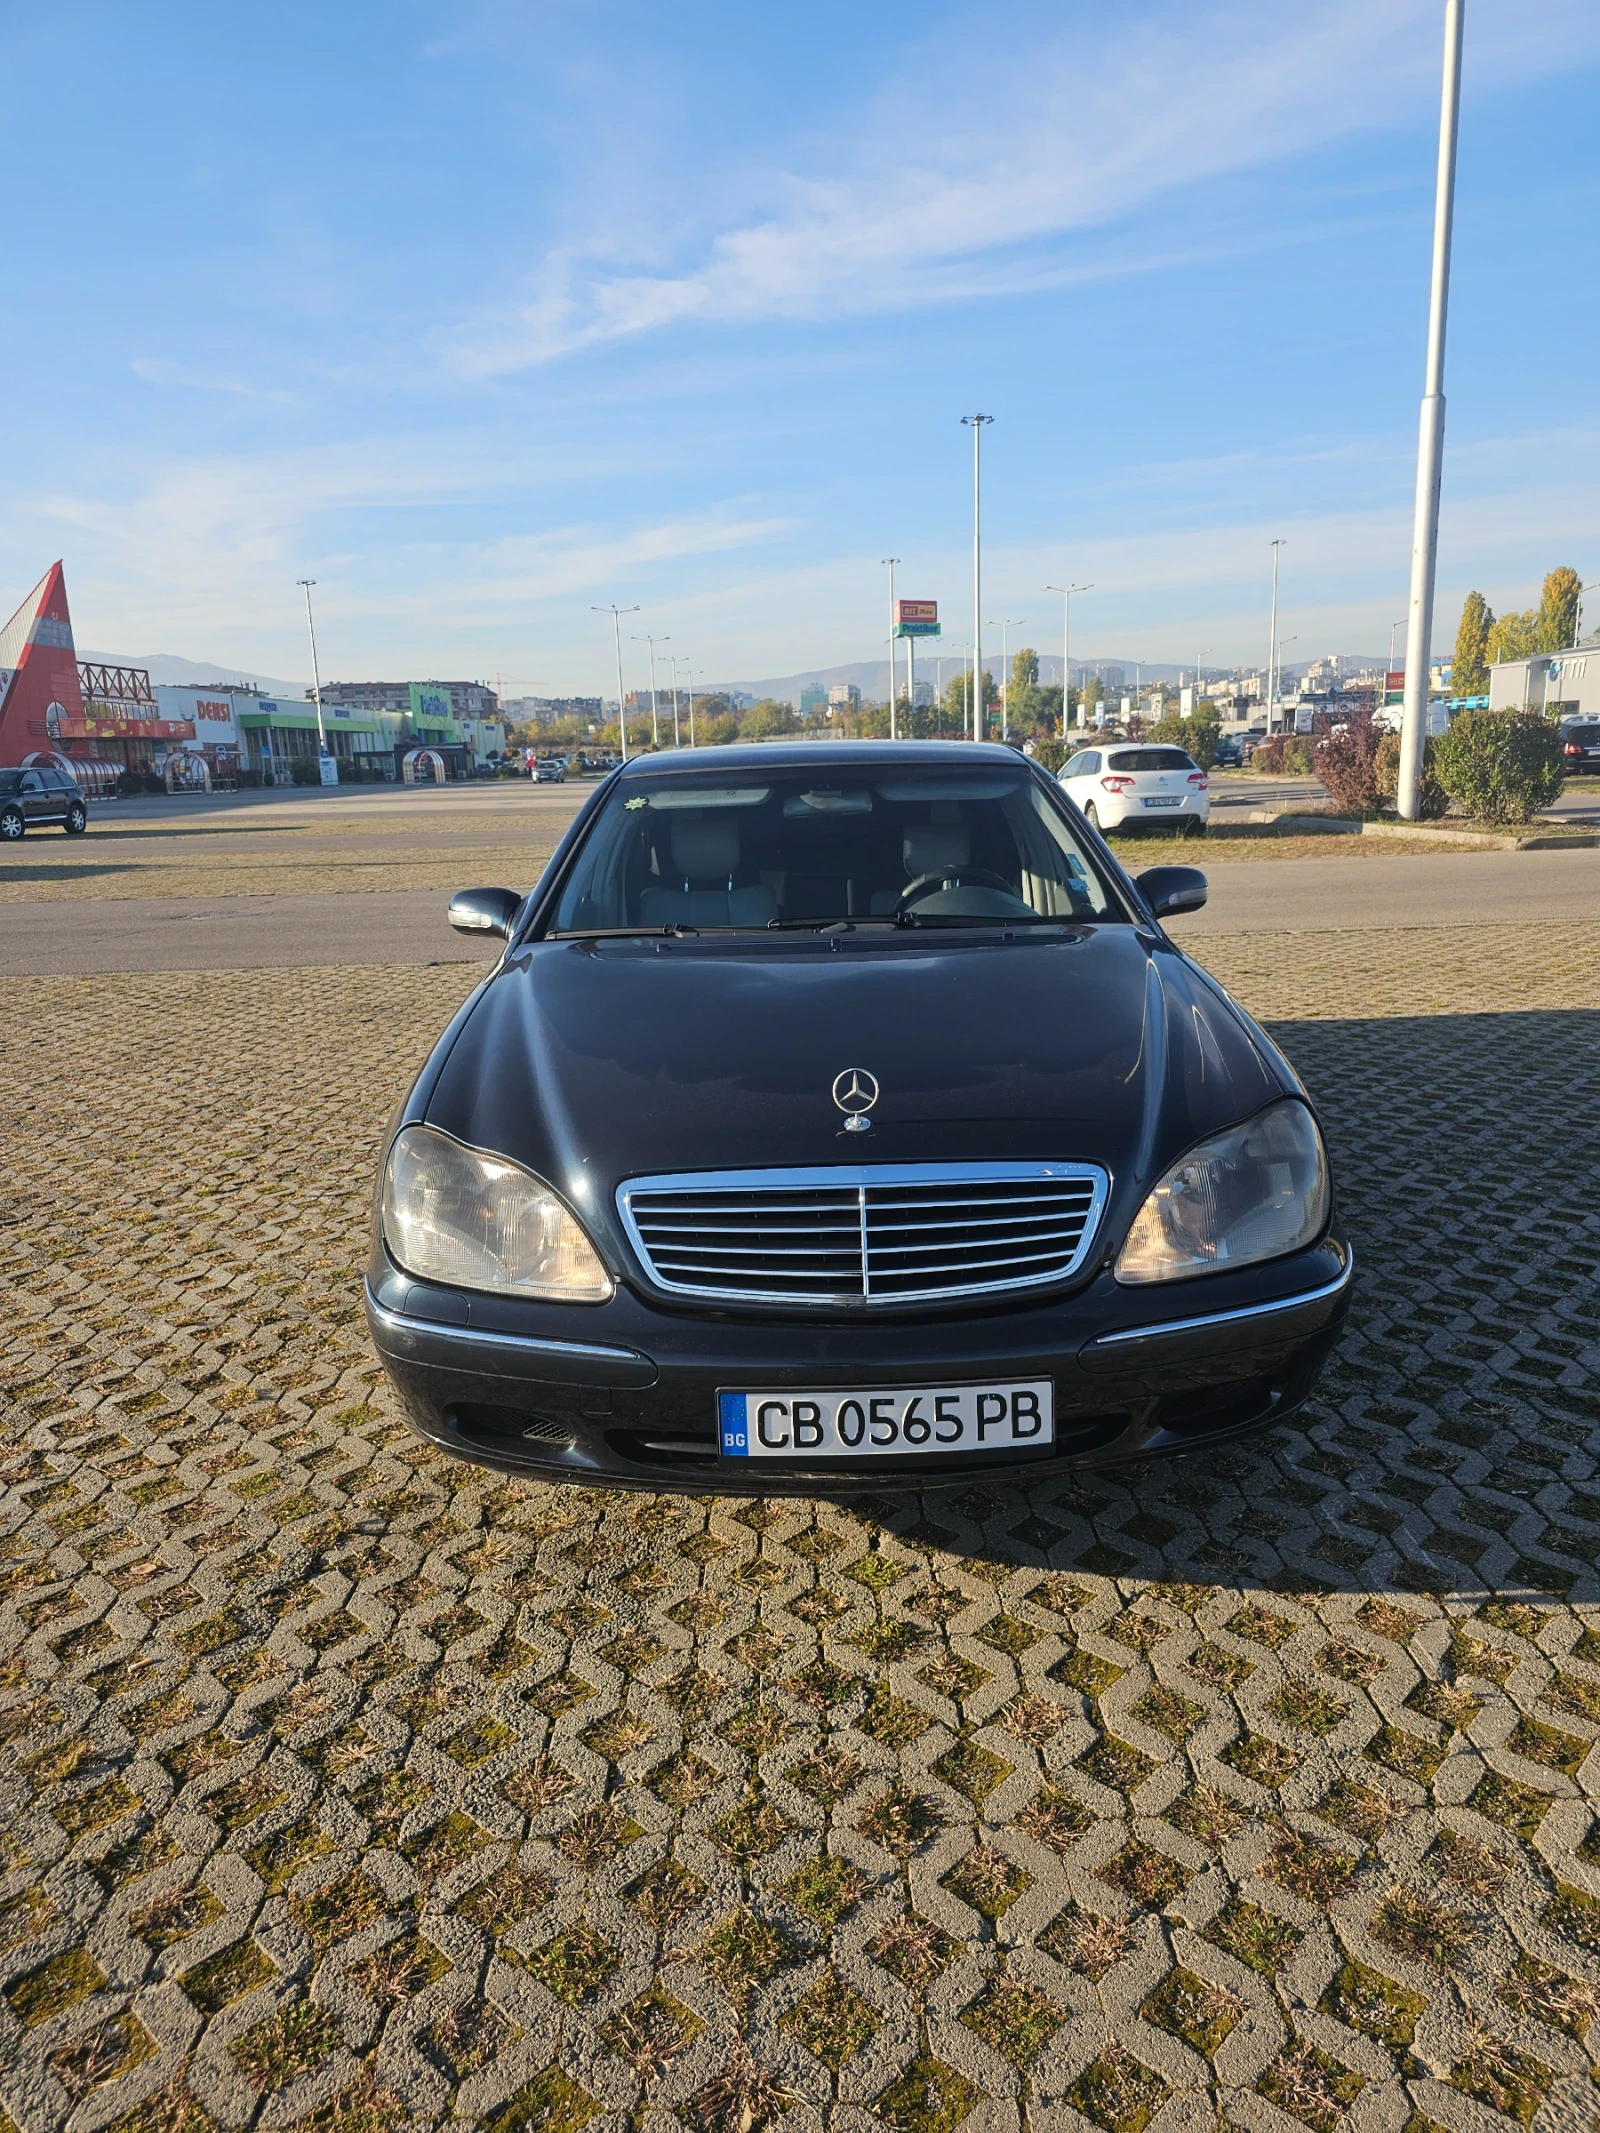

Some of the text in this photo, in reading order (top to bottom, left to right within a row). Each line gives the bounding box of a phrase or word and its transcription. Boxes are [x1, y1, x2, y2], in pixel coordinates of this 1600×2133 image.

[1560, 658, 1587, 680] ГТП
[756, 1390, 1042, 1449] CB 0565 PB
[724, 1432, 746, 1447] BG
